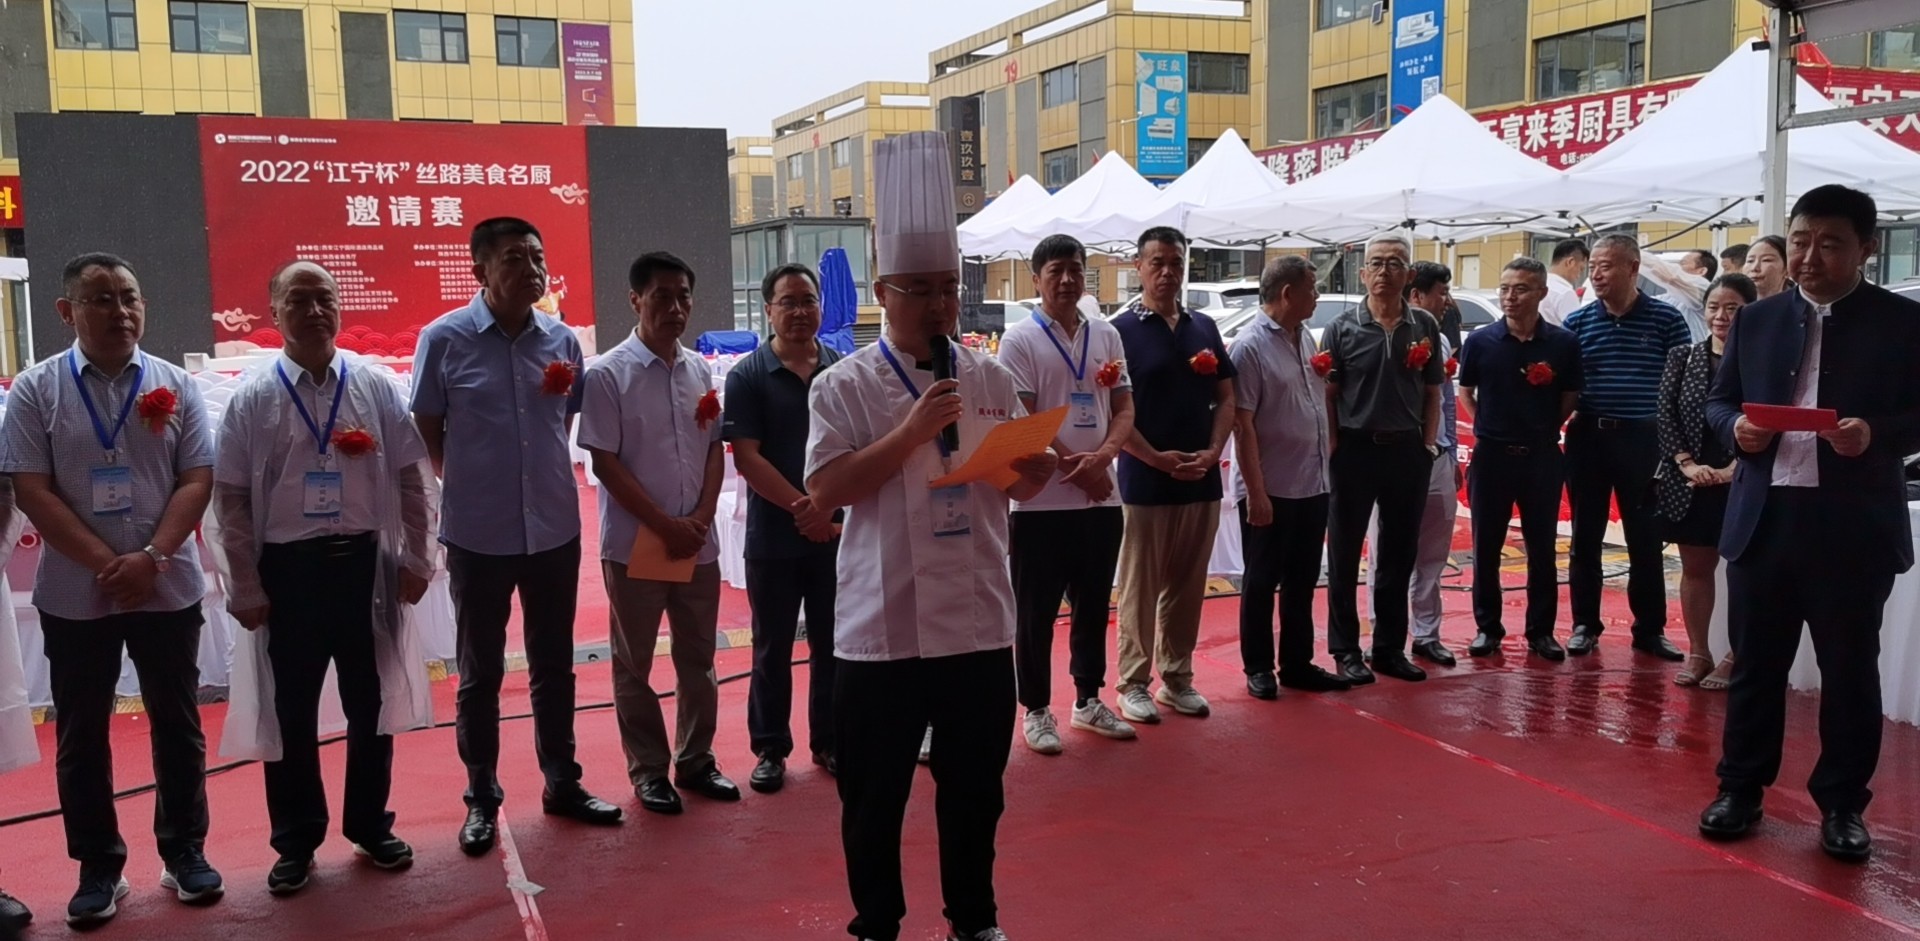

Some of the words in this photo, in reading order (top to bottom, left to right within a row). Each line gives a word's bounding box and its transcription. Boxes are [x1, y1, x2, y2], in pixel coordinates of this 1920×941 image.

[1005, 60, 1017, 83] 19
[960, 129, 975, 181] 壹玖玖壹
[346, 195, 464, 227] 邀请赛
